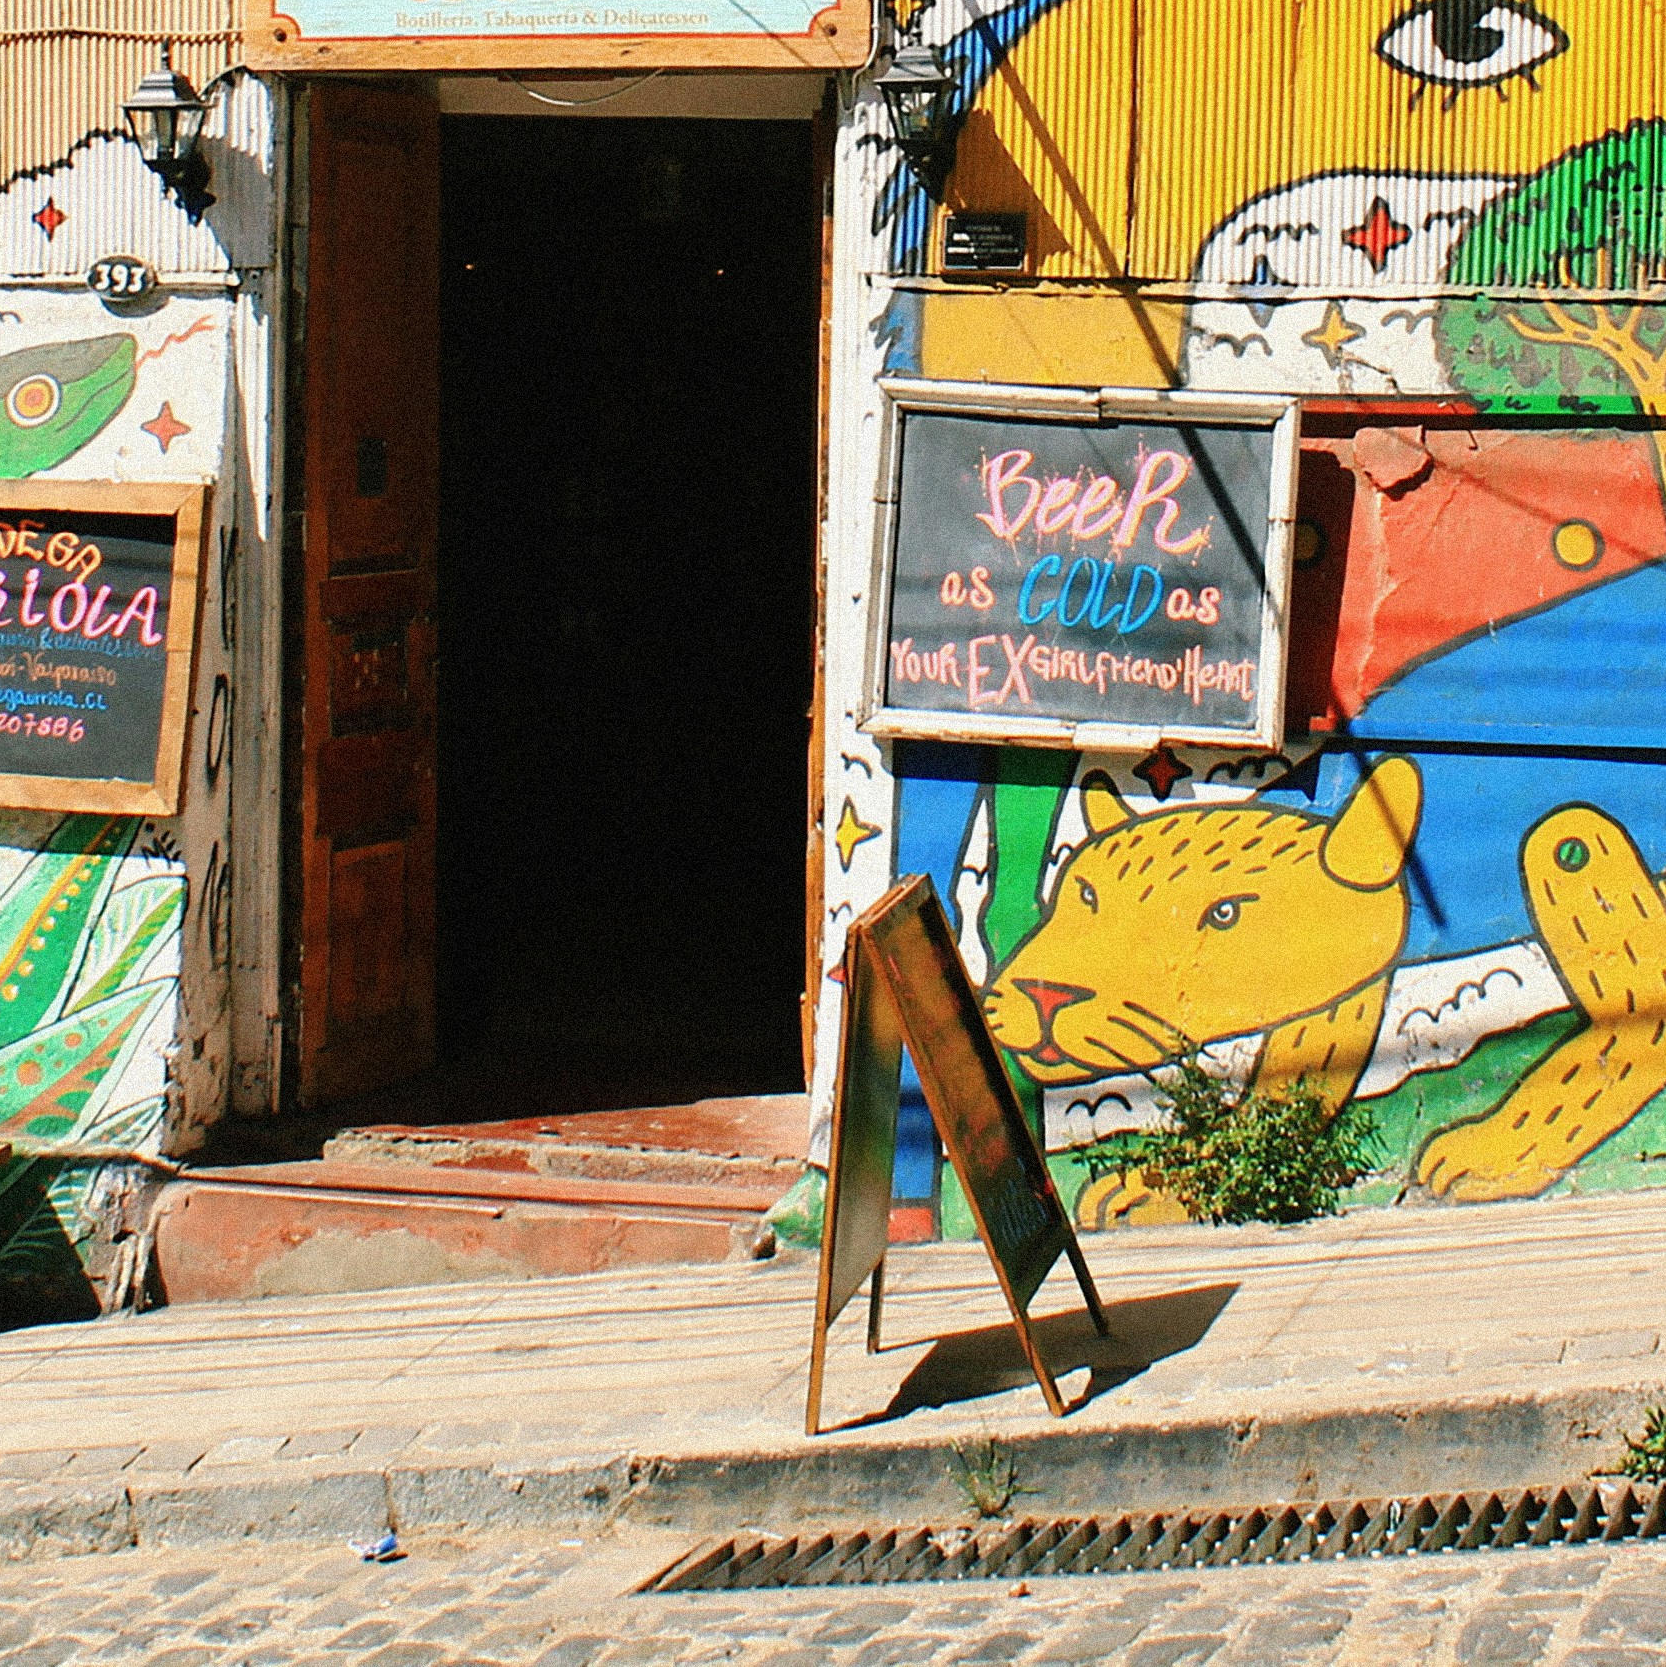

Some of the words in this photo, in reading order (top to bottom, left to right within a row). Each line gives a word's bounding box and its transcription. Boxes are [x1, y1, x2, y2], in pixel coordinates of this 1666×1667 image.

[583, 10, 597, 24] &
[95, 264, 146, 293] 393
[940, 565, 996, 610] as
[1017, 553, 1164, 634] COLD
[1166, 586, 1223, 624] as
